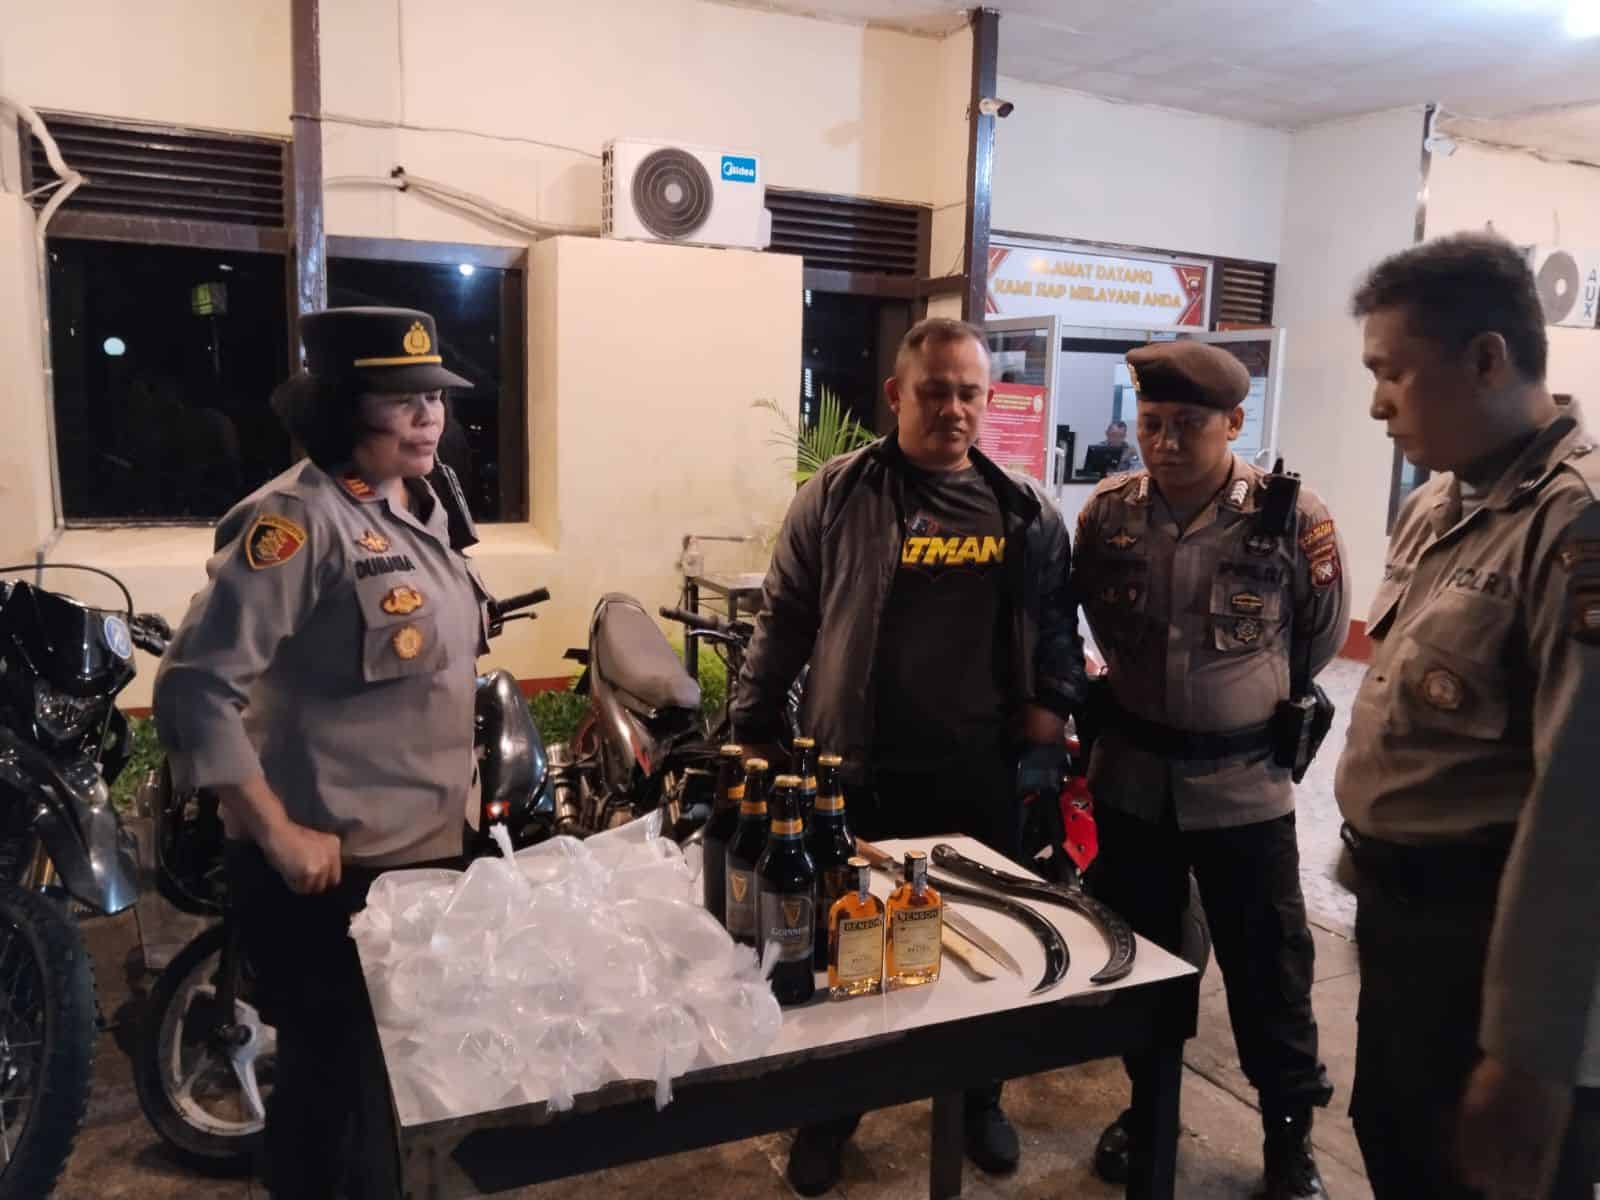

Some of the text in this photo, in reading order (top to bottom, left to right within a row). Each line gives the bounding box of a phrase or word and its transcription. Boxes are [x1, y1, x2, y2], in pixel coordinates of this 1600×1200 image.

[1030, 256, 1153, 284] LAMAT DATANG
[993, 279, 1182, 308] KAMI SIAP MELAYANI ANDA
[1582, 268, 1598, 319] AUX
[901, 535, 1006, 565] TMAN
